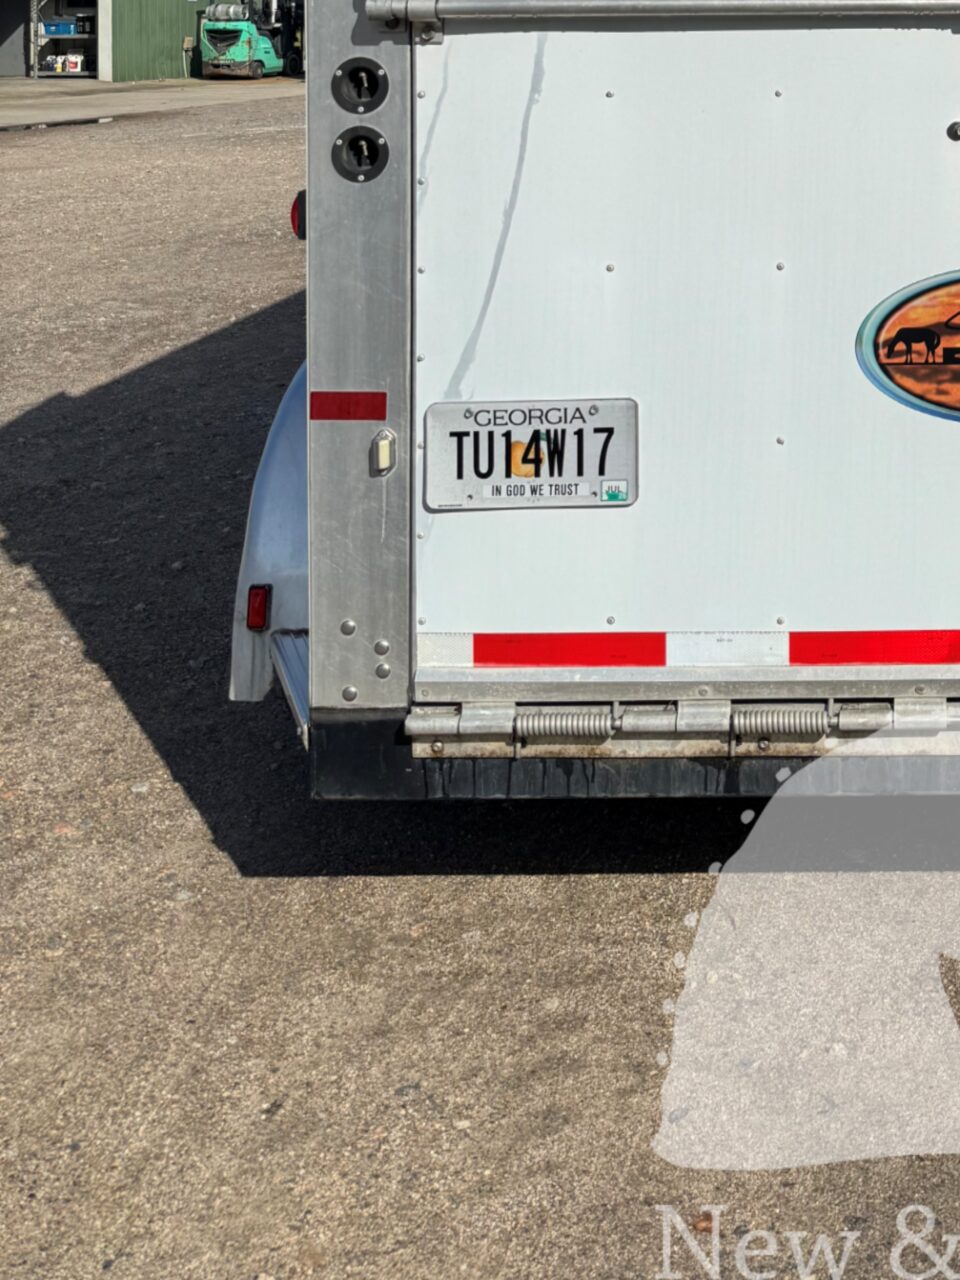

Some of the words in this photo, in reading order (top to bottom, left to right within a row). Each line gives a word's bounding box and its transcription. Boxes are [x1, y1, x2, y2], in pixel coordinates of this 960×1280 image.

[474, 407, 586, 426] GEORGIA
[449, 427, 615, 480] TU14W17
[492, 485, 501, 496] IN
[506, 484, 525, 496] GOD
[530, 484, 544, 495] WE
[549, 483, 579, 495] TRUST
